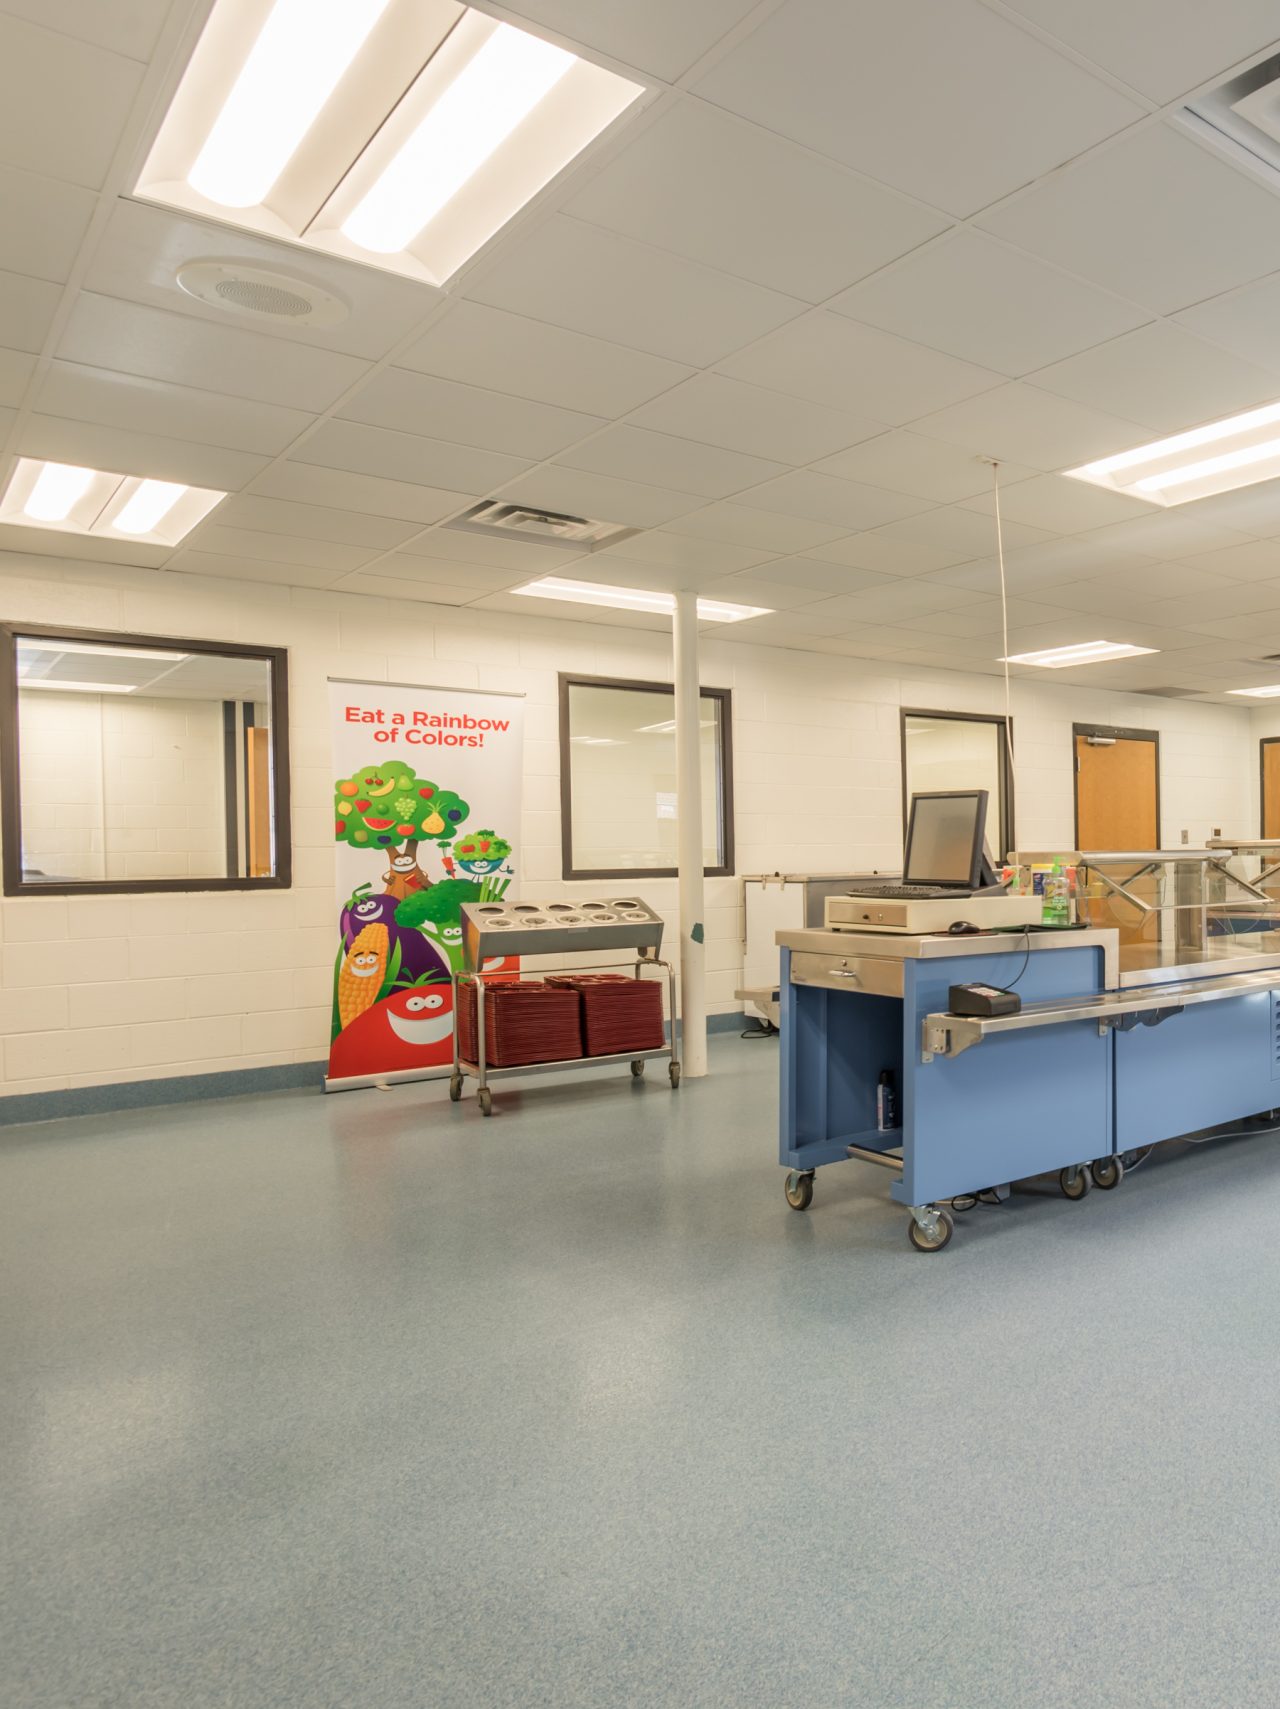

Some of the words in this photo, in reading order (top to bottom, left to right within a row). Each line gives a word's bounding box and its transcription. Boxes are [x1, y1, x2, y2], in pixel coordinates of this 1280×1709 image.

[345, 707, 385, 724] Eat
[391, 713, 405, 726] a
[412, 711, 510, 732] Rainbow
[373, 728, 399, 743] of
[404, 729, 484, 748] Colors!
